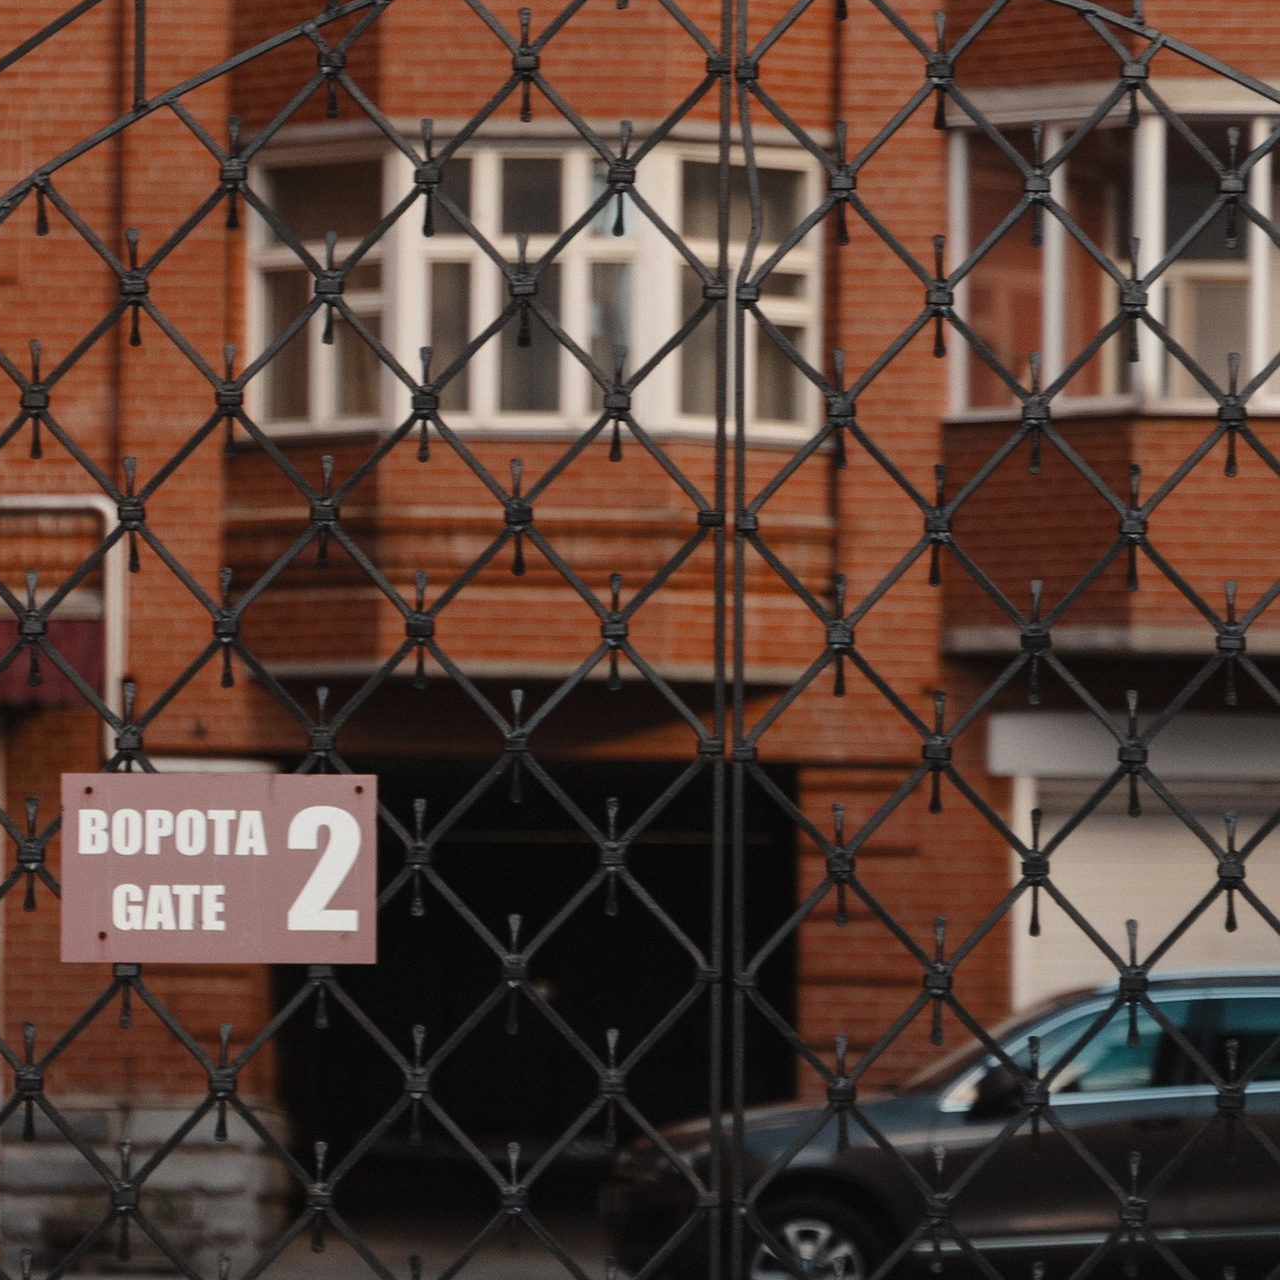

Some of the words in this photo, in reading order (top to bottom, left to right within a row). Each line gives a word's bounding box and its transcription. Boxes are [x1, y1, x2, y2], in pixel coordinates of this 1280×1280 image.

[78, 808, 268, 856] ВОРОТА
[287, 805, 362, 931] 2
[112, 883, 226, 931] GATE
